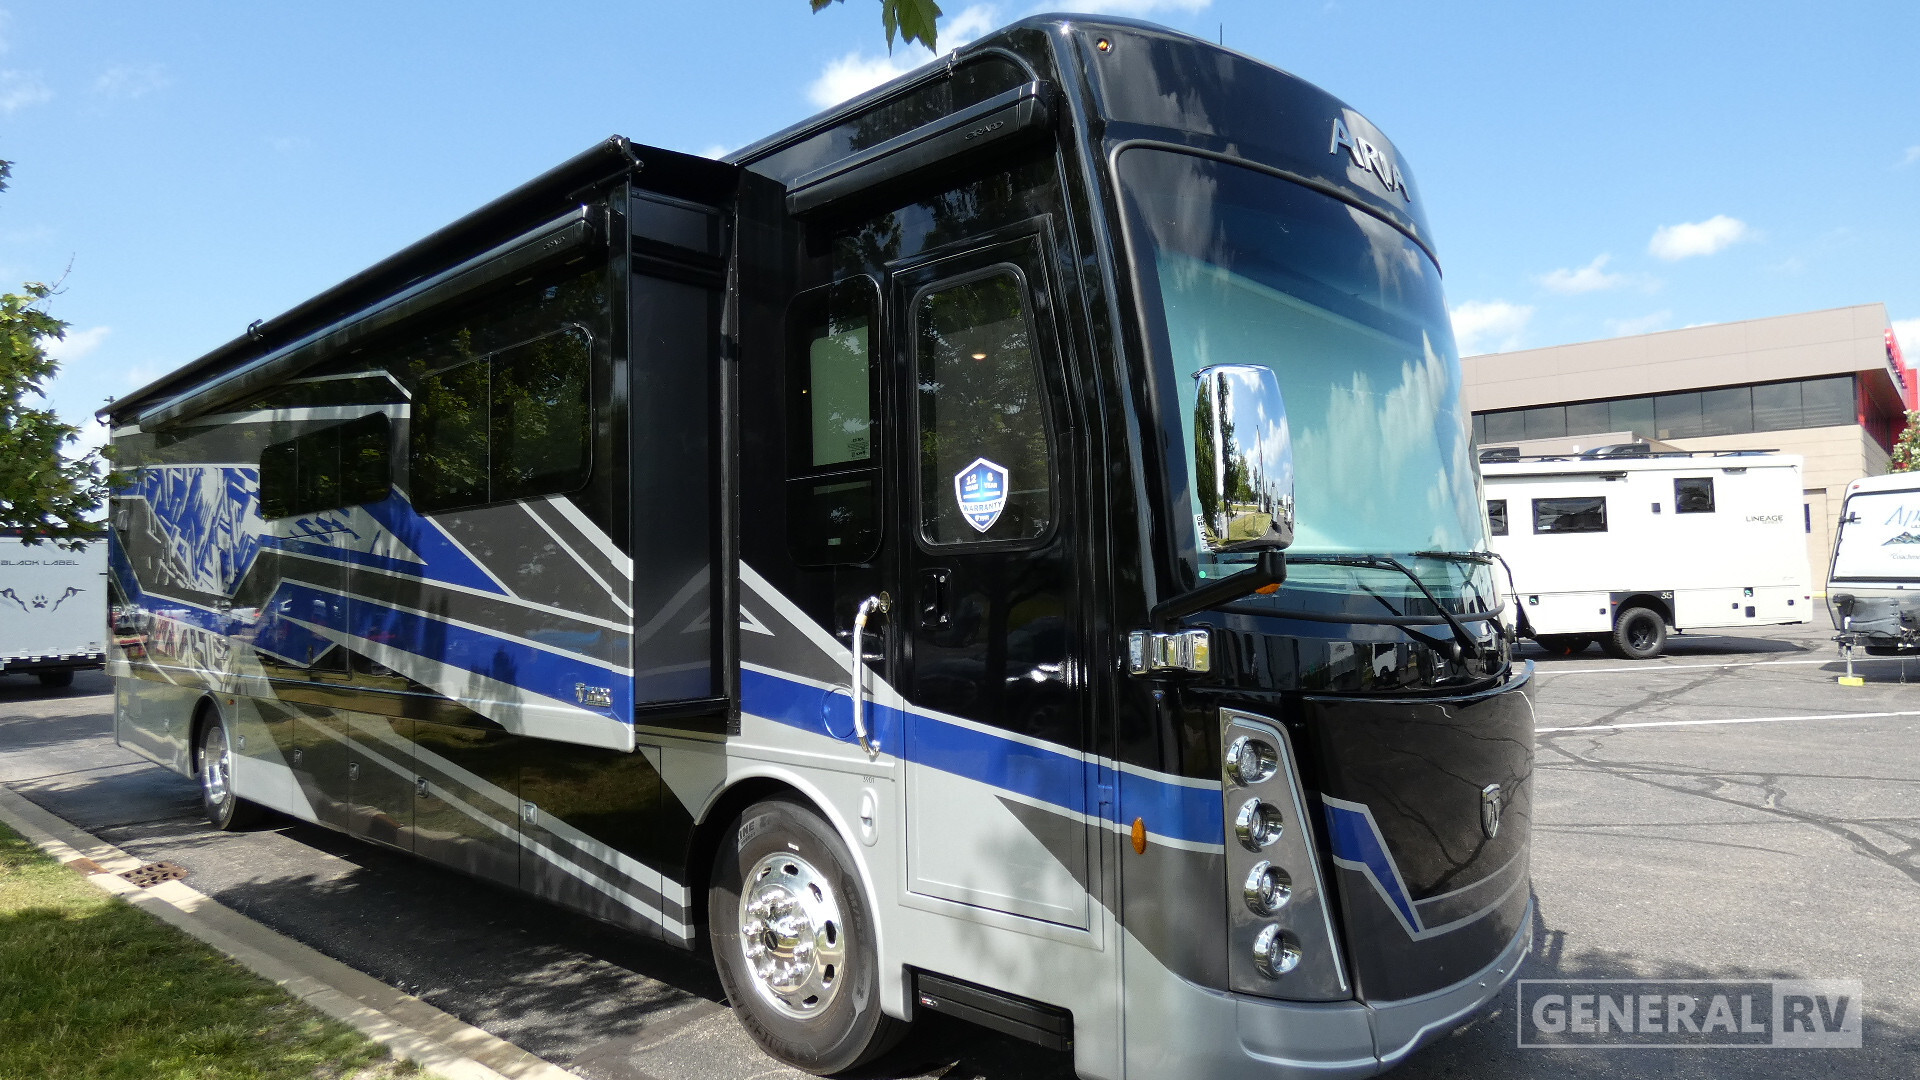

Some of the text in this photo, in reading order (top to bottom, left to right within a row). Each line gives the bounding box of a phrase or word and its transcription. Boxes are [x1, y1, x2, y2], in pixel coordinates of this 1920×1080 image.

[966, 473, 977, 486] 12
[962, 500, 1003, 512] WARRANTY
[1745, 514, 1784, 522] LINEAGE
[1661, 591, 1674, 600] 35
